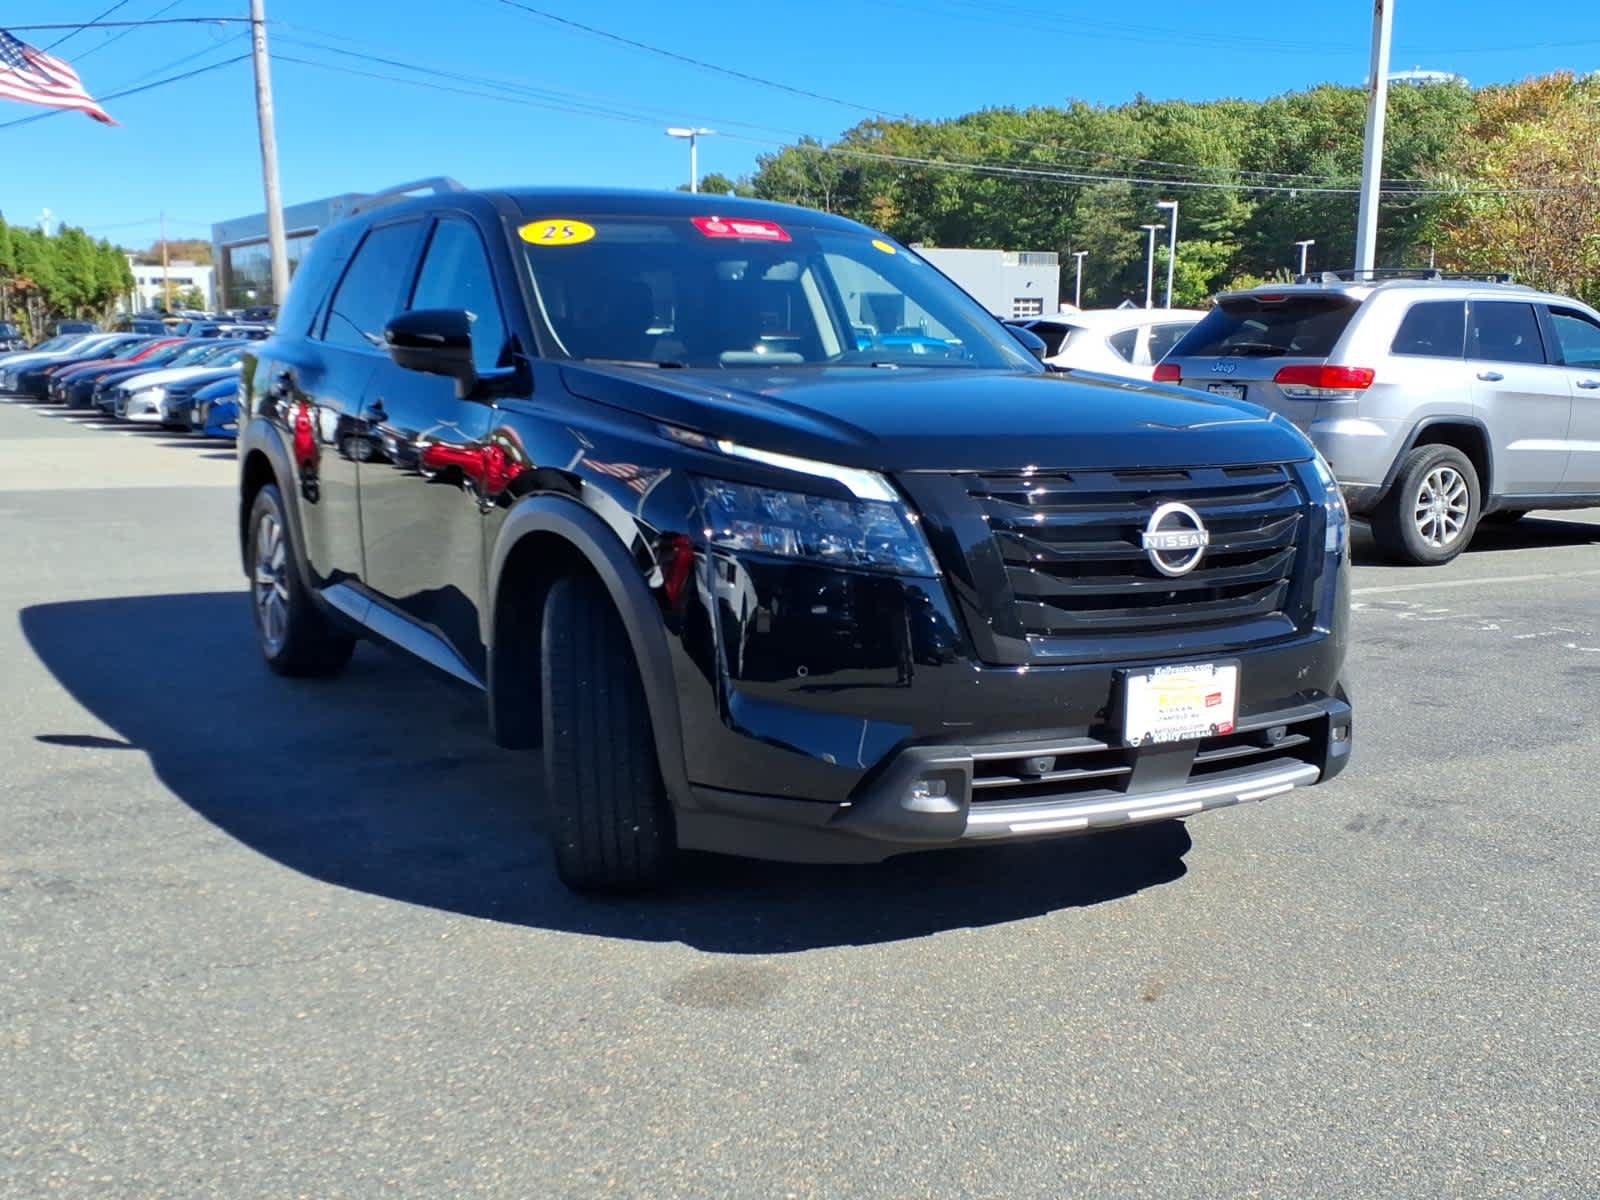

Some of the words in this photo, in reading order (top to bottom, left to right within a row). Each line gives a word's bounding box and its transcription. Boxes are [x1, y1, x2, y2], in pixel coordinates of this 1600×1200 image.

[542, 225, 576, 241] 25
[1211, 361, 1236, 374] Jeep
[1144, 535, 1208, 549] NISSAN
